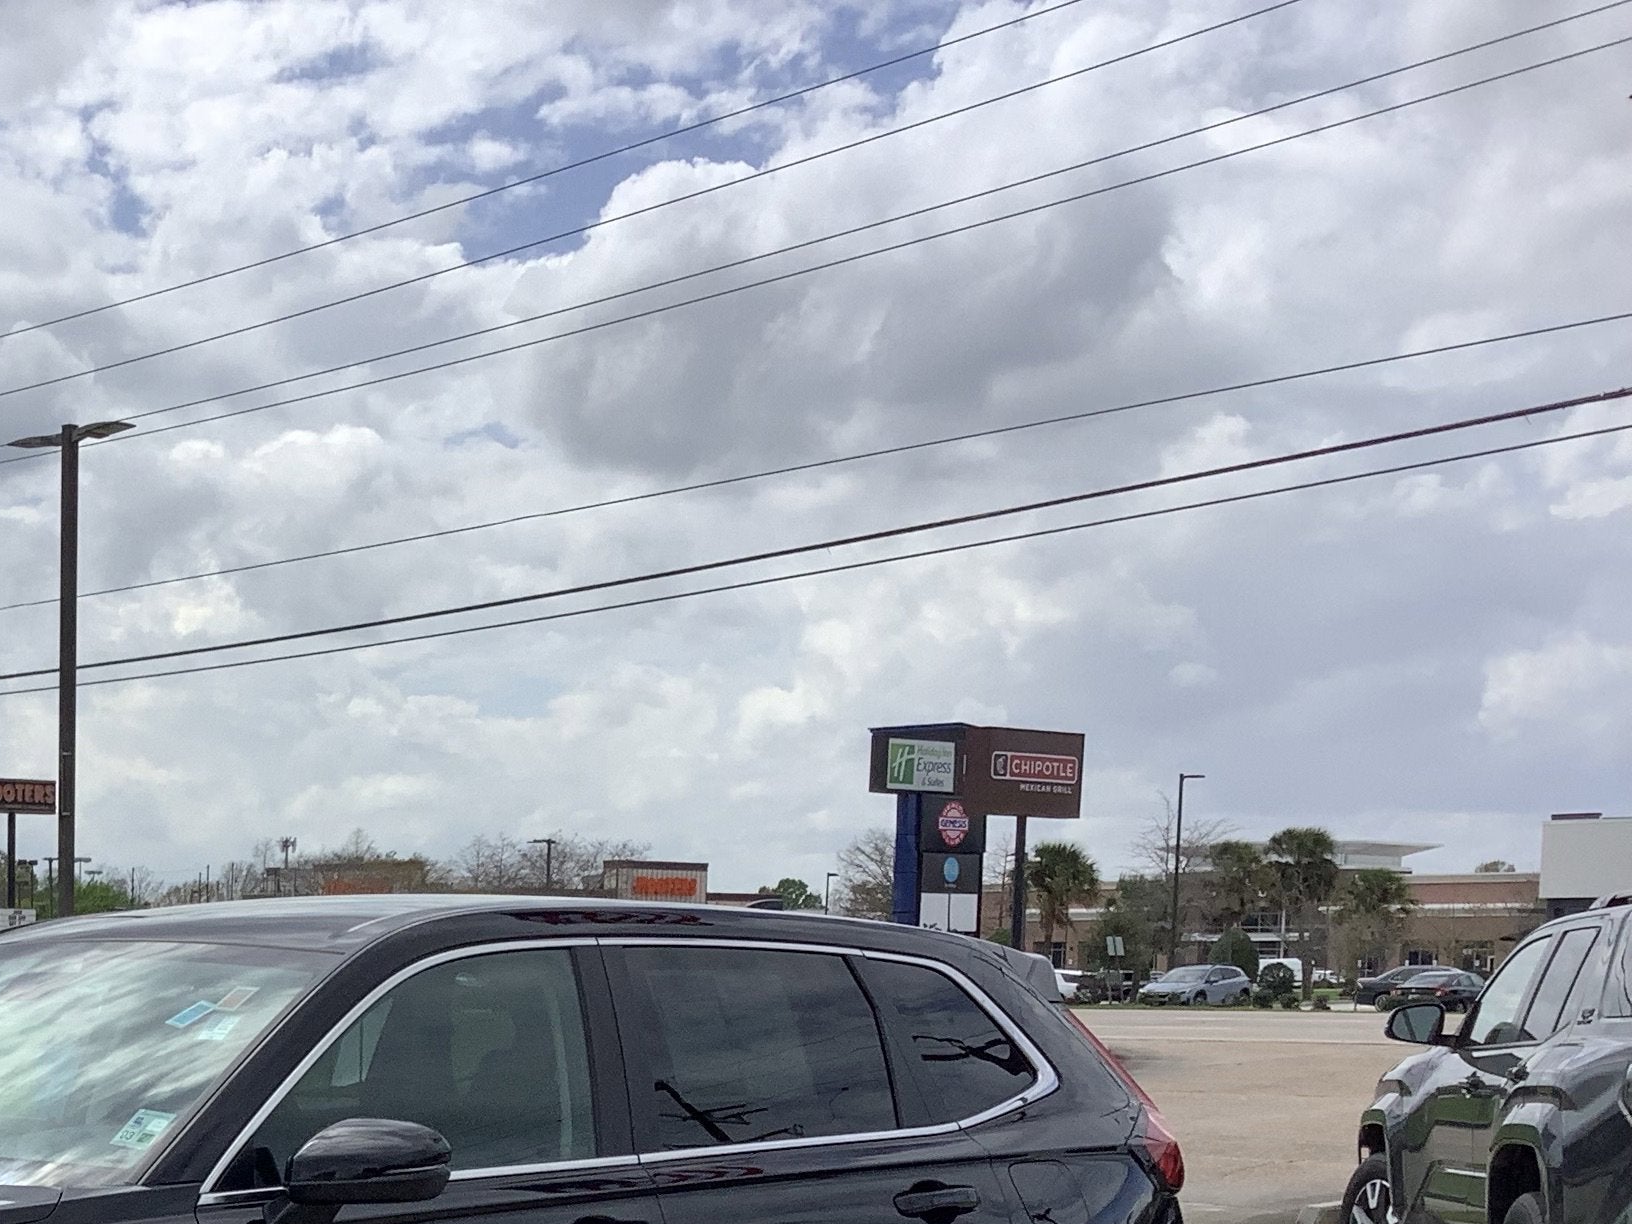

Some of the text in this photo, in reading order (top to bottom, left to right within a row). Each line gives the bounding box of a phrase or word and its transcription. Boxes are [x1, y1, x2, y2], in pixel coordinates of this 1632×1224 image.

[916, 757, 952, 776] Express
[1012, 760, 1074, 777] CHIPOTLE
[1020, 784, 1073, 794] MEXICAN GRILL
